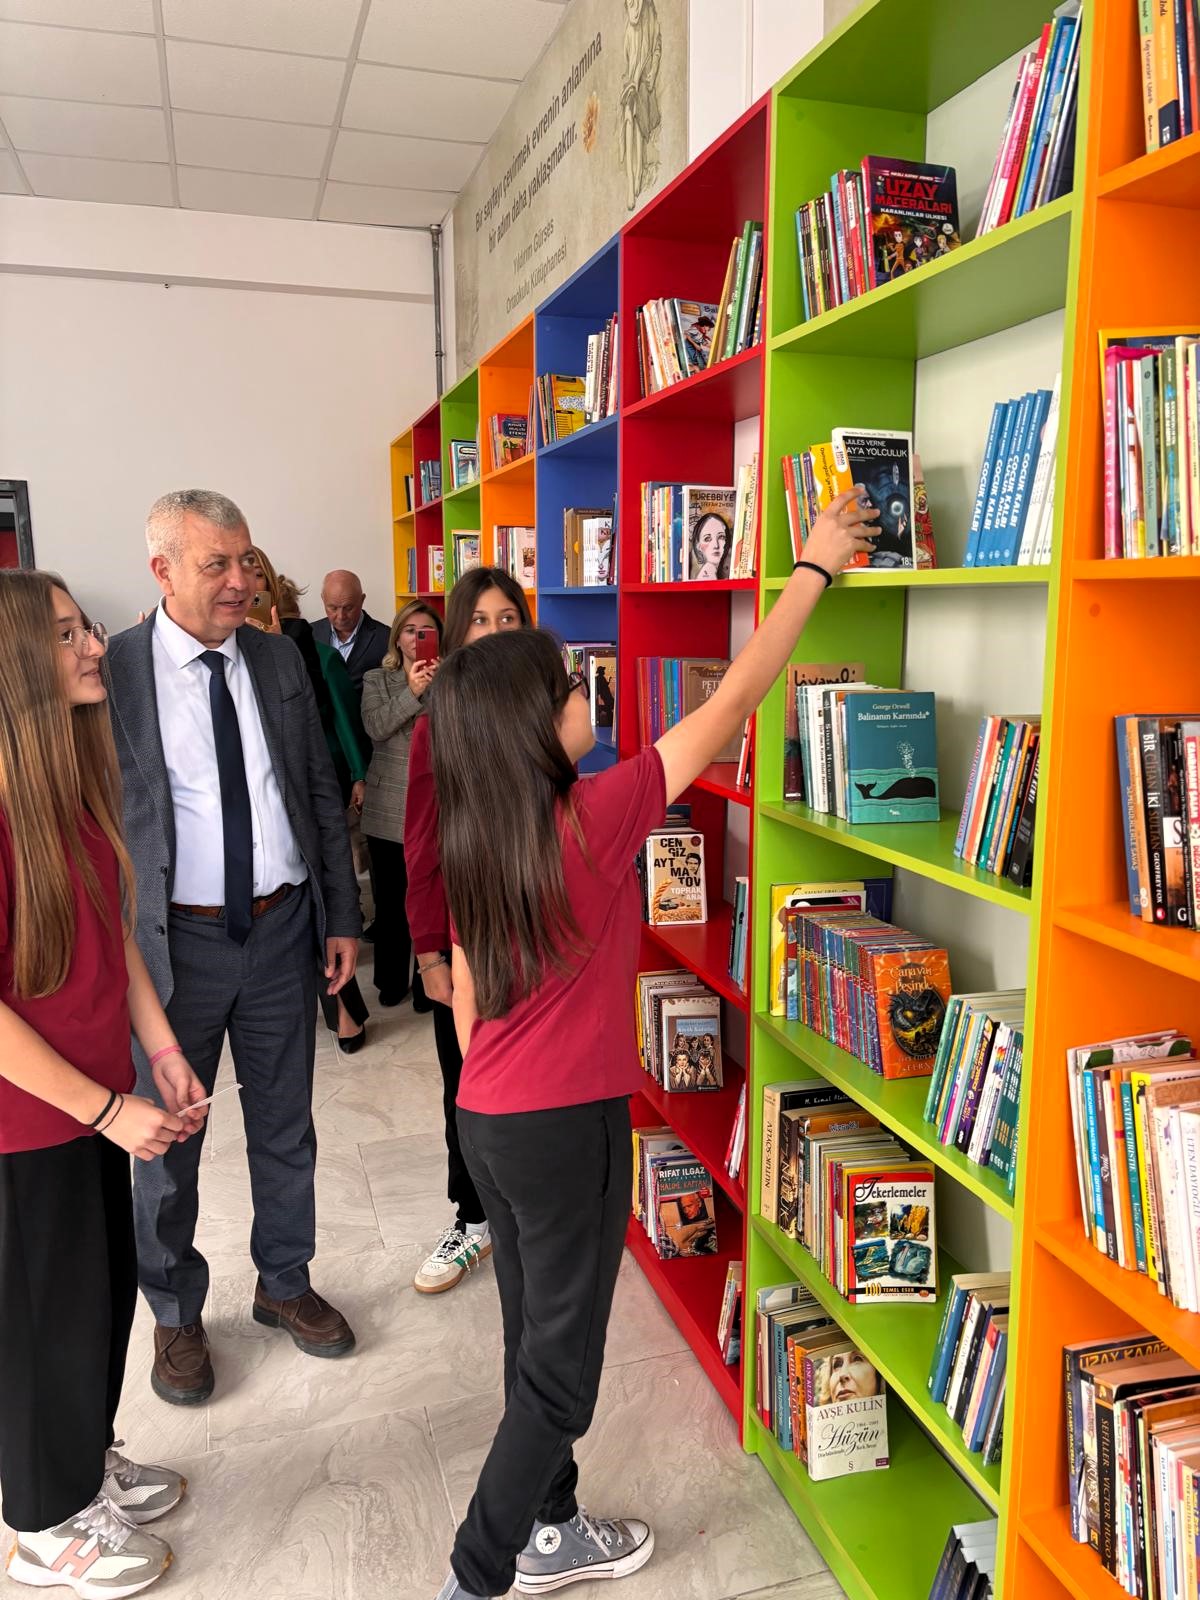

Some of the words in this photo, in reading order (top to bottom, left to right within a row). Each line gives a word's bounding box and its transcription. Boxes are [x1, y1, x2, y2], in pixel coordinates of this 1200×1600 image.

[475, 209, 483, 232] Bir
[484, 181, 502, 221] sayfayı
[503, 134, 531, 197] çevirmek
[532, 95, 560, 150] evrenin
[562, 32, 602, 108] anlamına
[488, 228, 497, 254] bir
[497, 212, 511, 244] adım
[511, 189, 528, 223] daha
[528, 121, 577, 208] yaklaşmaktır.
[886, 178, 938, 200] UZAY
[875, 194, 952, 214] MACERALARI
[533, 218, 554, 251] Gürses
[506, 281, 529, 314] Ortaokulu
[530, 236, 567, 291] Kütüphanesi
[846, 447, 865, 455] AY'A
[866, 448, 908, 457] YOLCULUK
[857, 712, 891, 721] Balinanın
[1143, 734, 1156, 752] BİR
[1145, 752, 1157, 790] CİHAN
[1147, 792, 1160, 808] İKİ
[1149, 809, 1161, 849] SULTAN
[660, 838, 683, 848] CEN
[668, 848, 687, 858] GİZ
[653, 858, 676, 868] AYT
[670, 867, 690, 877] MA
[1153, 852, 1162, 889] GEOFFREY
[678, 877, 701, 887] TOV
[906, 1062, 932, 1072] FERN
[1122, 1095, 1134, 1131] AGATHA
[1126, 1132, 1137, 1172] CHRISTIE
[659, 1169, 681, 1178] RIFAT
[682, 1166, 705, 1176] ILGAZ
[855, 1176, 927, 1202] Tekerlemeler
[865, 1283, 881, 1297] 100
[1080, 1351, 1119, 1368] UZAY
[817, 1405, 843, 1421] AYŞE
[846, 1399, 883, 1415] KULİN
[818, 1421, 880, 1456] Hüzün
[1101, 1418, 1110, 1467] SEFİLLER
[1103, 1476, 1111, 1518] VICTOR
[1104, 1521, 1112, 1558] HUGO
